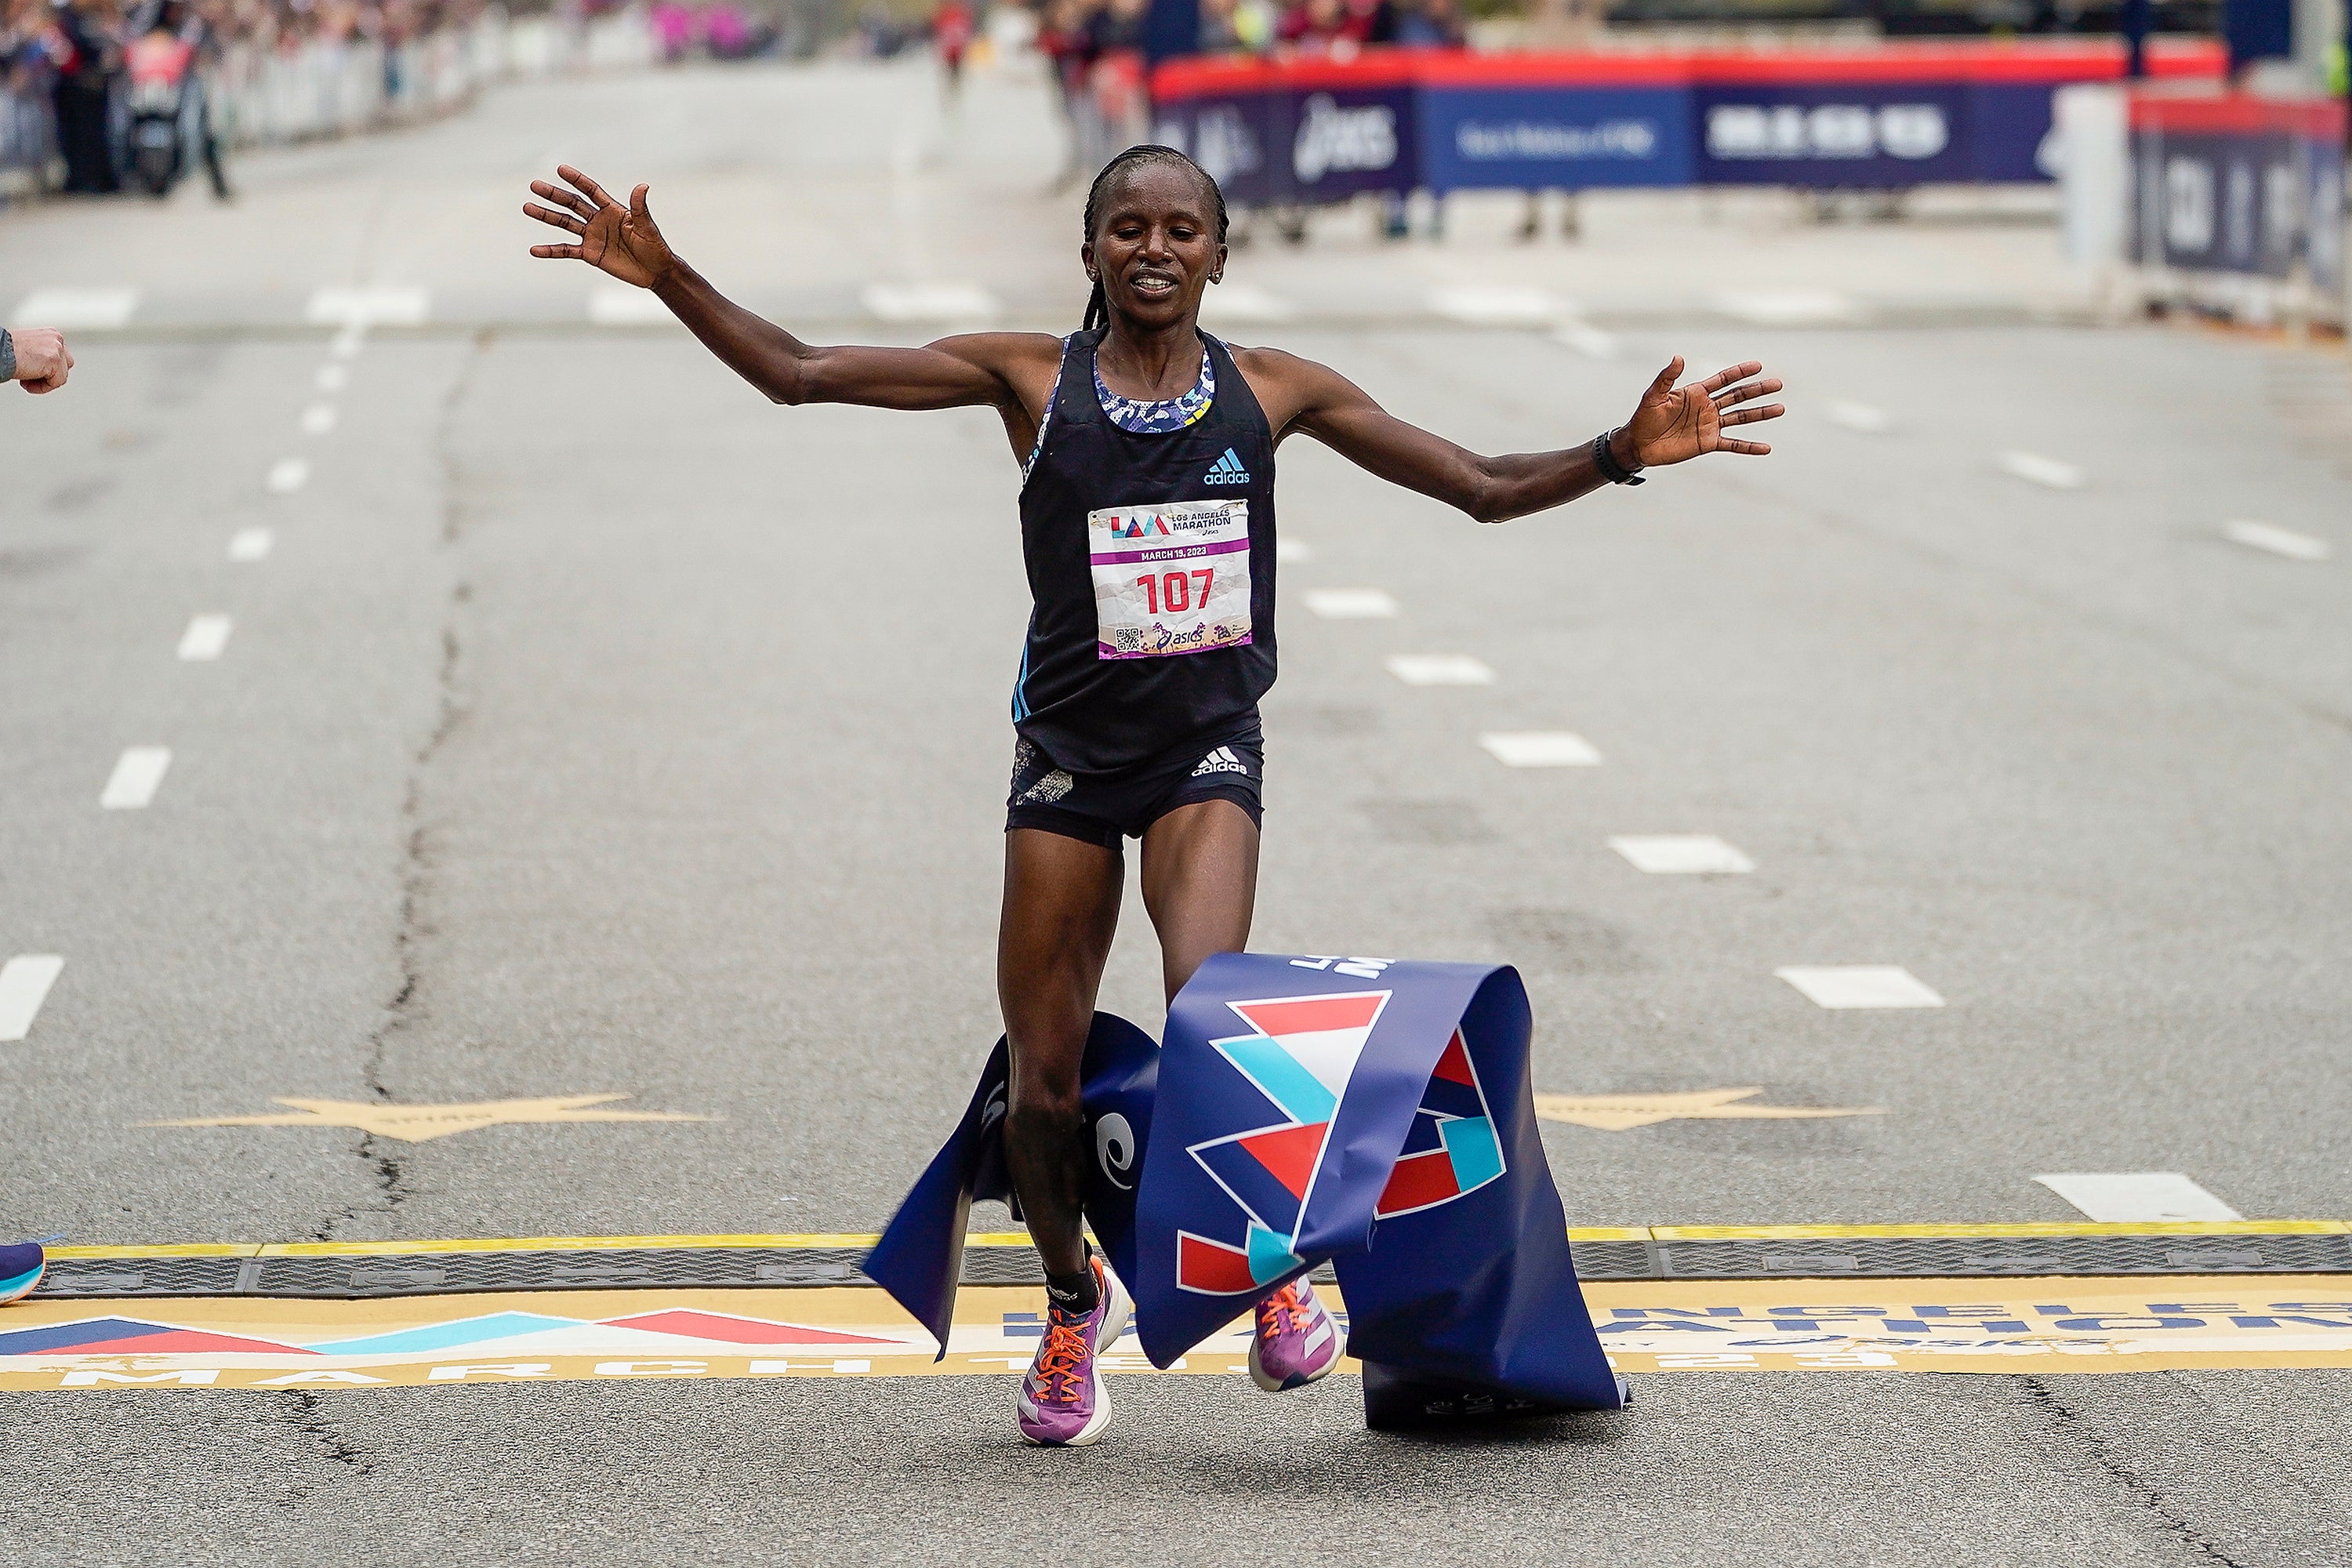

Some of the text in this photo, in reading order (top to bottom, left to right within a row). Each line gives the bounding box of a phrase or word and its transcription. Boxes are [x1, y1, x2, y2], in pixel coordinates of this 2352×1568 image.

[1203, 470, 1250, 485] adidas
[1172, 509, 1230, 522] LOS ANGELES
[1173, 517, 1231, 531] MARATHON
[1141, 550, 1174, 561] MARCH
[1187, 546, 1207, 557] 2023
[1137, 568, 1214, 615] 107
[1173, 631, 1203, 644] asics
[1192, 760, 1248, 777] adidas
[59, 1359, 871, 1387] MARCH
